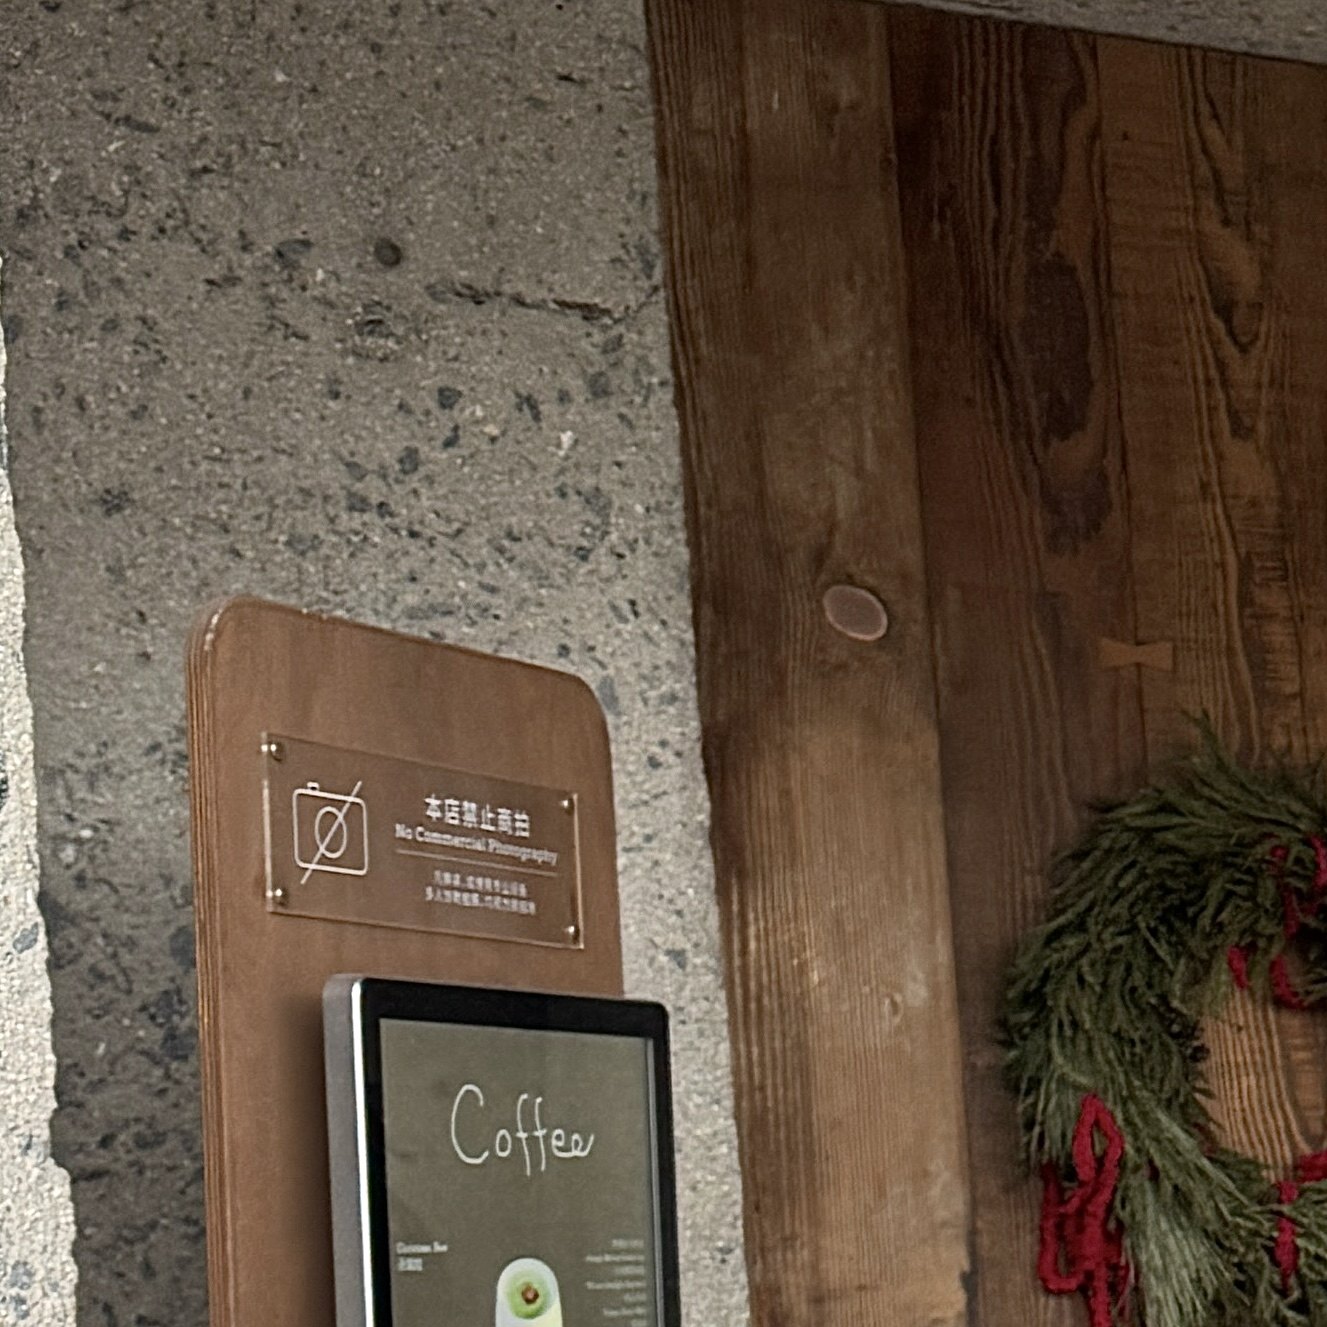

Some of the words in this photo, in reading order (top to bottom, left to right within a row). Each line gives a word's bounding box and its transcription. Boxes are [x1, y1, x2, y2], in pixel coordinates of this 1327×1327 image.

[395, 823, 413, 841] No
[424, 793, 531, 838] 本店禁止商拍
[451, 1083, 595, 1176] Coffee
